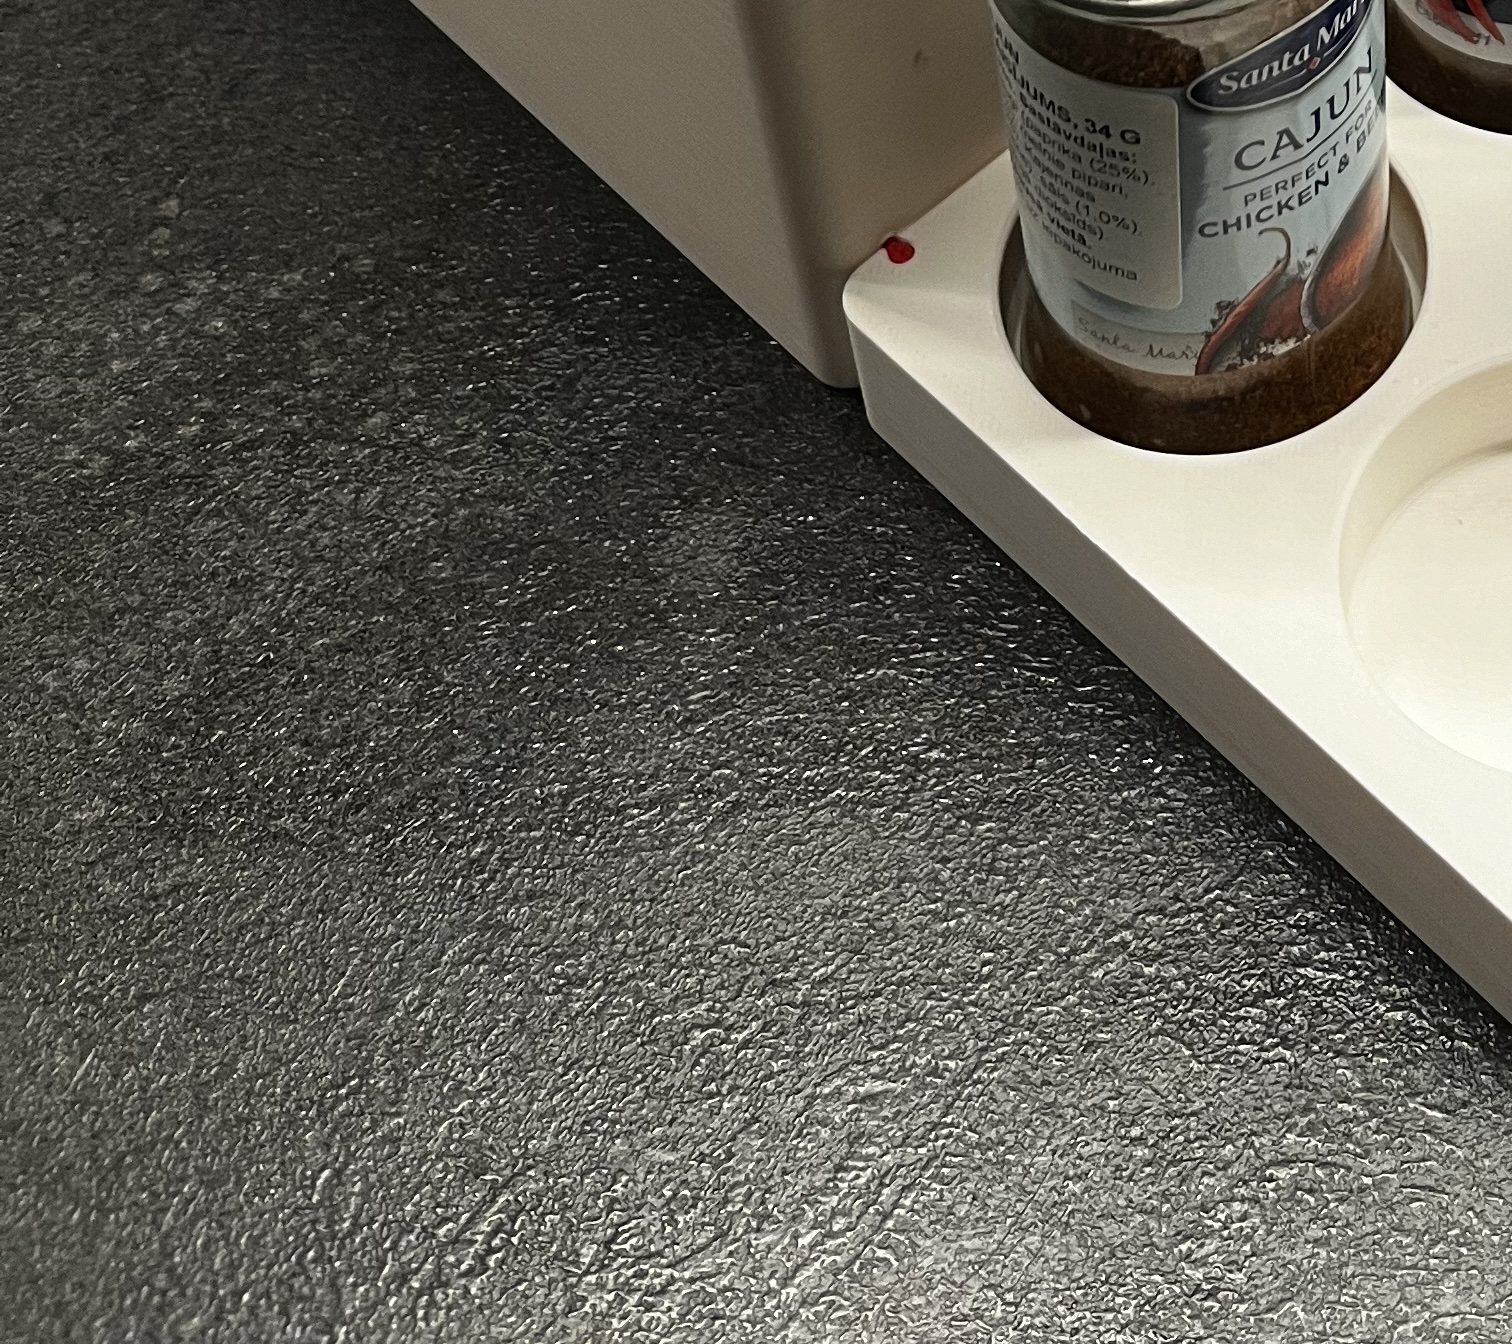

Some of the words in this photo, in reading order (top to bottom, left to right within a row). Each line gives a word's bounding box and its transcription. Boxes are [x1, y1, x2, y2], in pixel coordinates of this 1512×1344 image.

[1218, 43, 1311, 95] Santa
[1234, 45, 1373, 171] CAJUN
[1084, 117, 1113, 140] 34
[1119, 129, 1141, 146] G
[1243, 140, 1339, 207] PERFECT
[1346, 98, 1373, 144] FOR
[1198, 171, 1330, 239] CHICKEN
[1337, 152, 1352, 174] &
